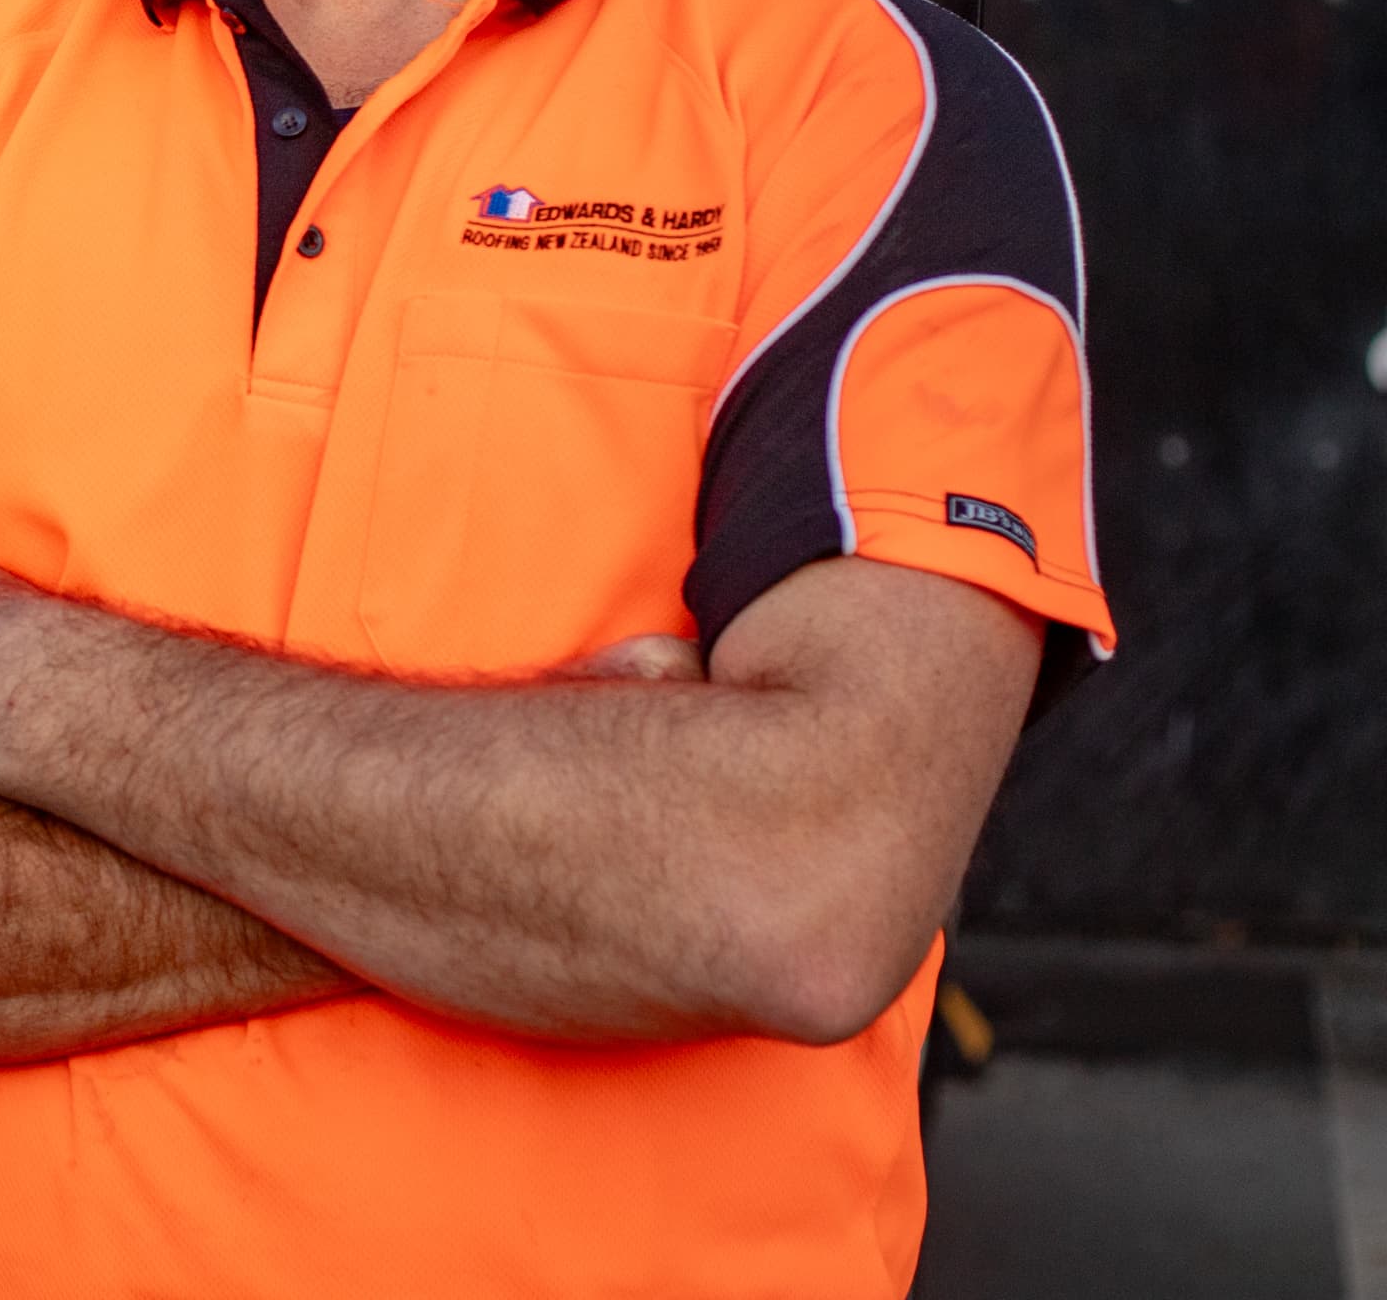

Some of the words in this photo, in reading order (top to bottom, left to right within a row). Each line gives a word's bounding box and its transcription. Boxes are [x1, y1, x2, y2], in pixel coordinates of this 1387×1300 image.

[535, 202, 634, 224] EDWARDS
[641, 207, 655, 228] &
[662, 204, 724, 230] HARDY
[461, 228, 530, 250] ROOFING
[534, 232, 566, 251] NEW
[570, 232, 641, 257] ZEALAND
[647, 243, 689, 261] SINCE
